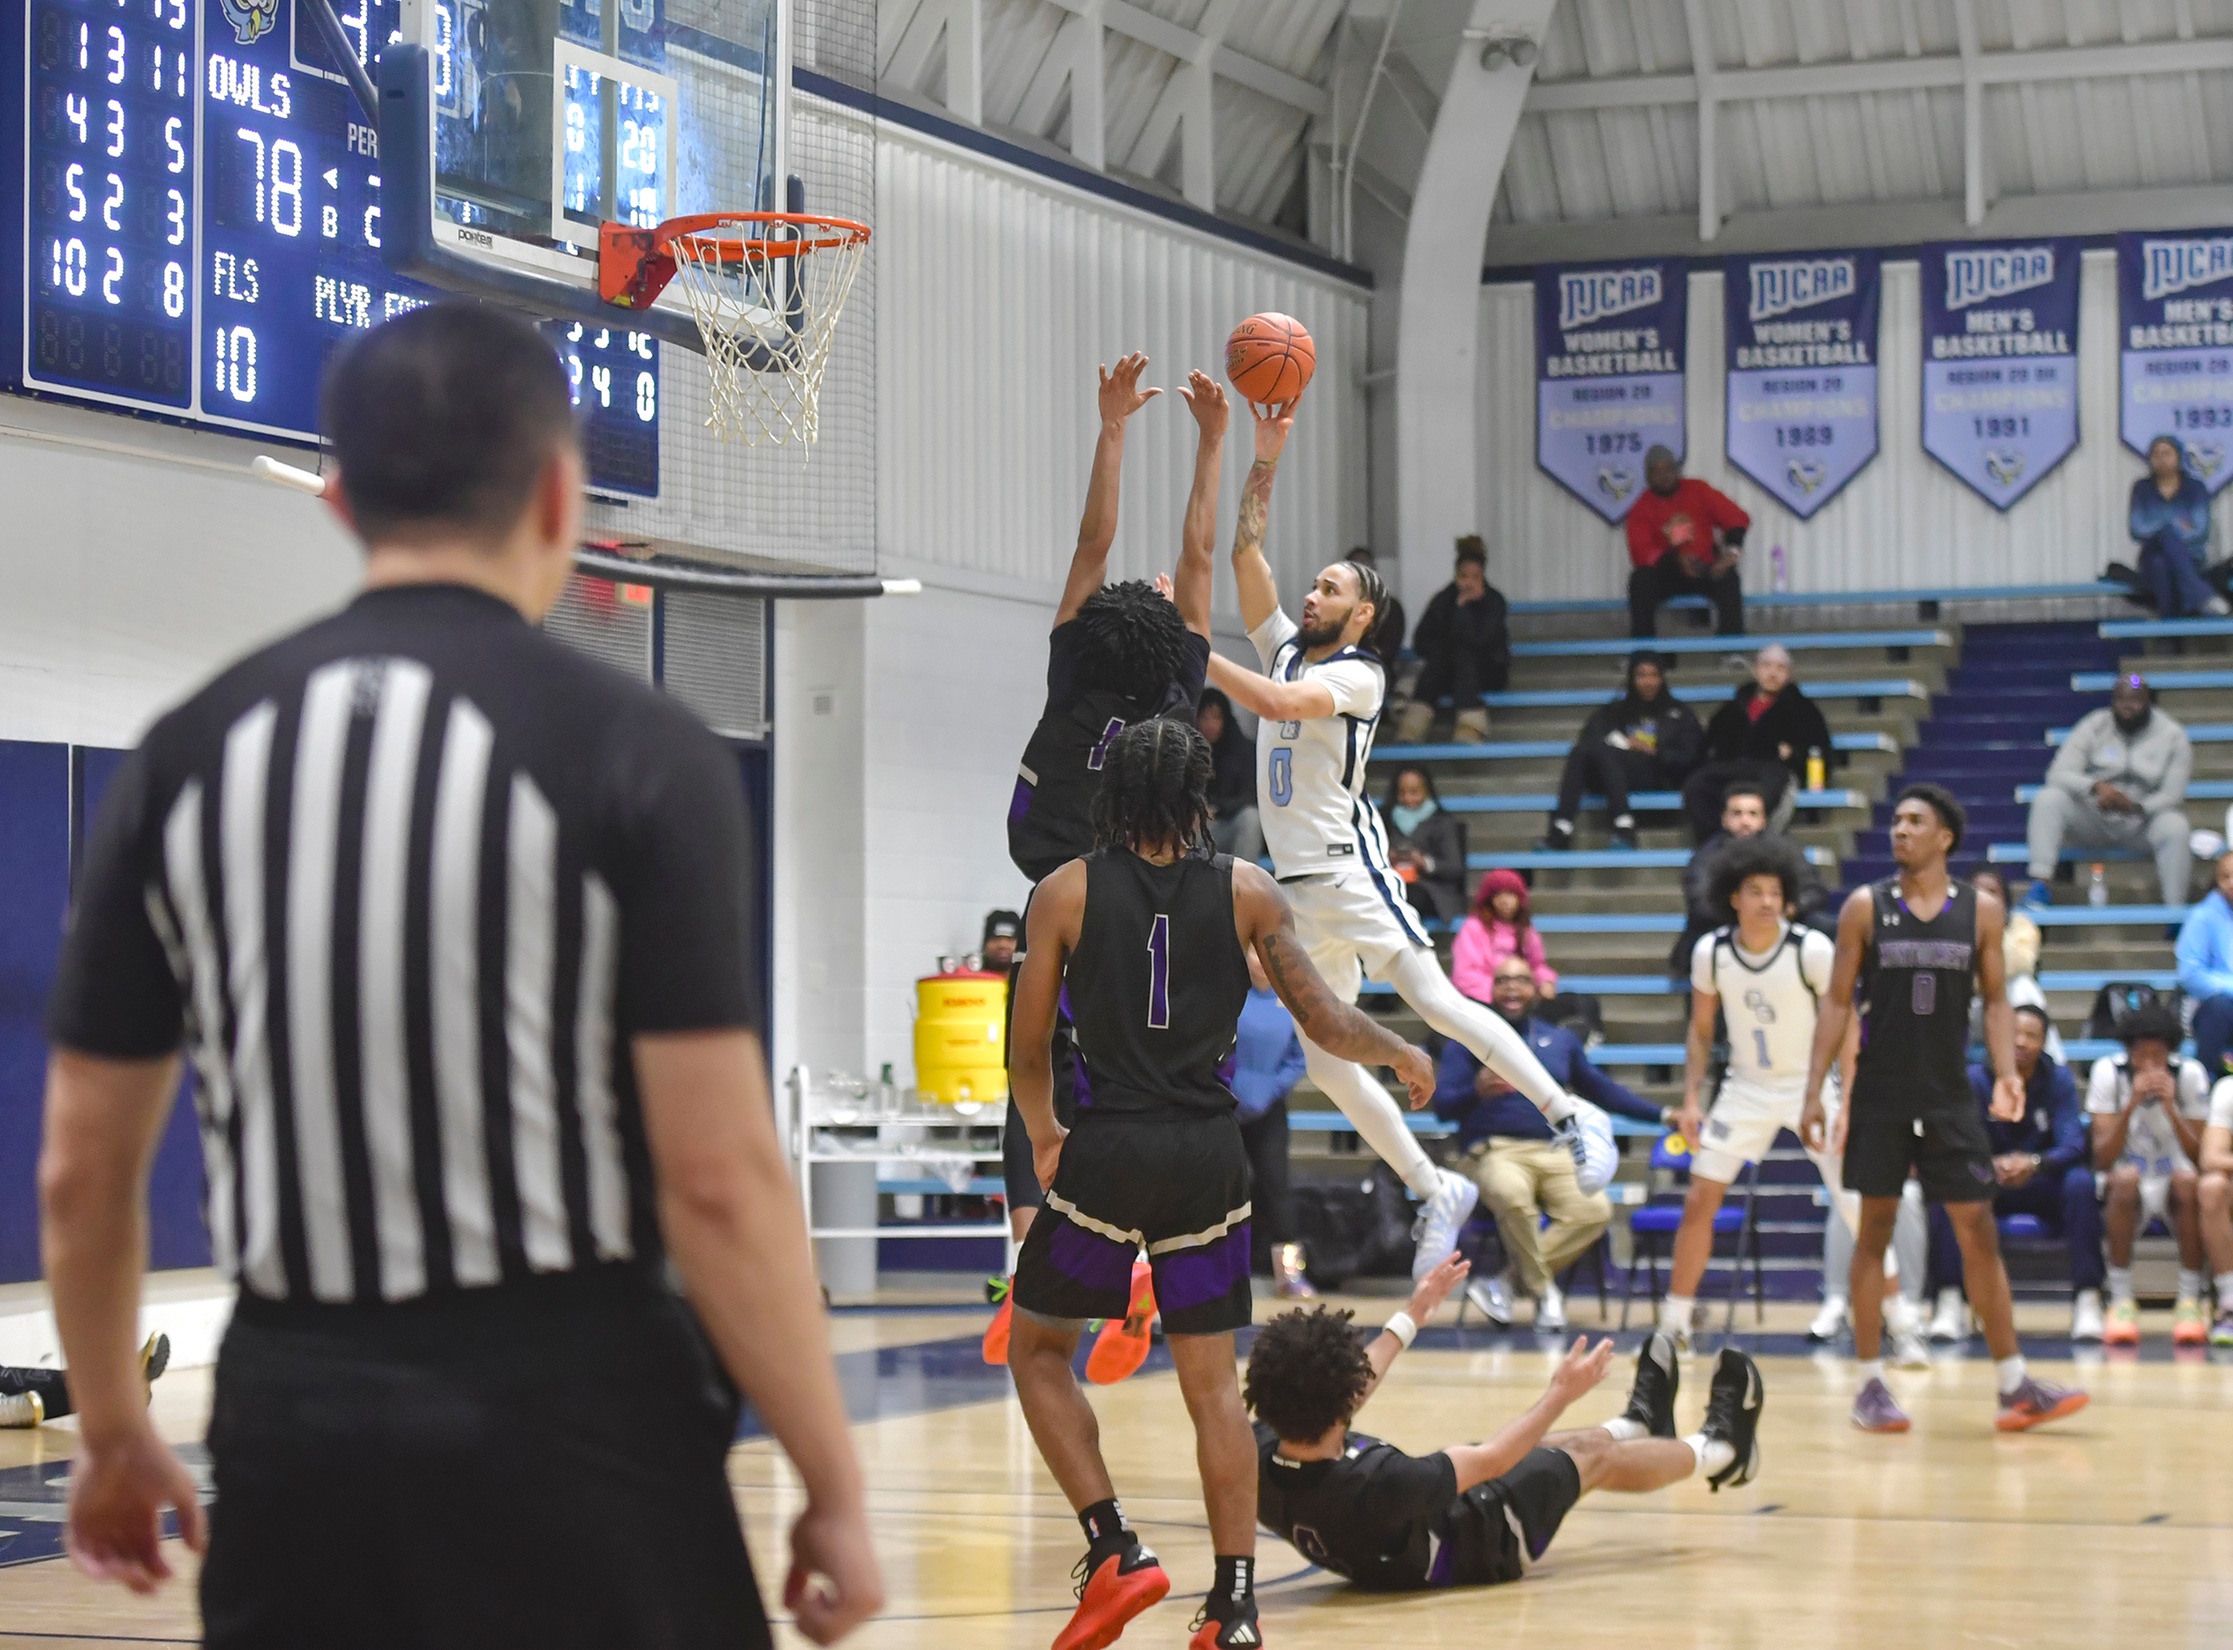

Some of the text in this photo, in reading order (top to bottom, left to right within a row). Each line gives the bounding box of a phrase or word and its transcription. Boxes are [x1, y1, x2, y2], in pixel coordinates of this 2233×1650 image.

[154, 45, 186, 98] 11
[208, 53, 292, 119] OWLS
[165, 116, 185, 173] 5
[237, 127, 303, 237] 78
[167, 189, 185, 246] 3
[322, 205, 338, 238] B
[163, 262, 184, 318] 8
[213, 250, 260, 303] FLS
[314, 275, 371, 328] PLYR
[1565, 275, 1656, 322] NJCAA
[1756, 265, 1848, 314] NJCAA
[1954, 253, 2047, 301] NJCAA
[215, 325, 257, 402] 10
[1546, 349, 1677, 377] BASKETBALL
[1737, 341, 1869, 368] BASKETBALL
[1932, 330, 2070, 359] BASKETBALL
[636, 371, 655, 422] 0
[1269, 747, 1293, 807] 0
[1147, 913, 1169, 1029] 1
[1753, 1030, 1771, 1069] 1
